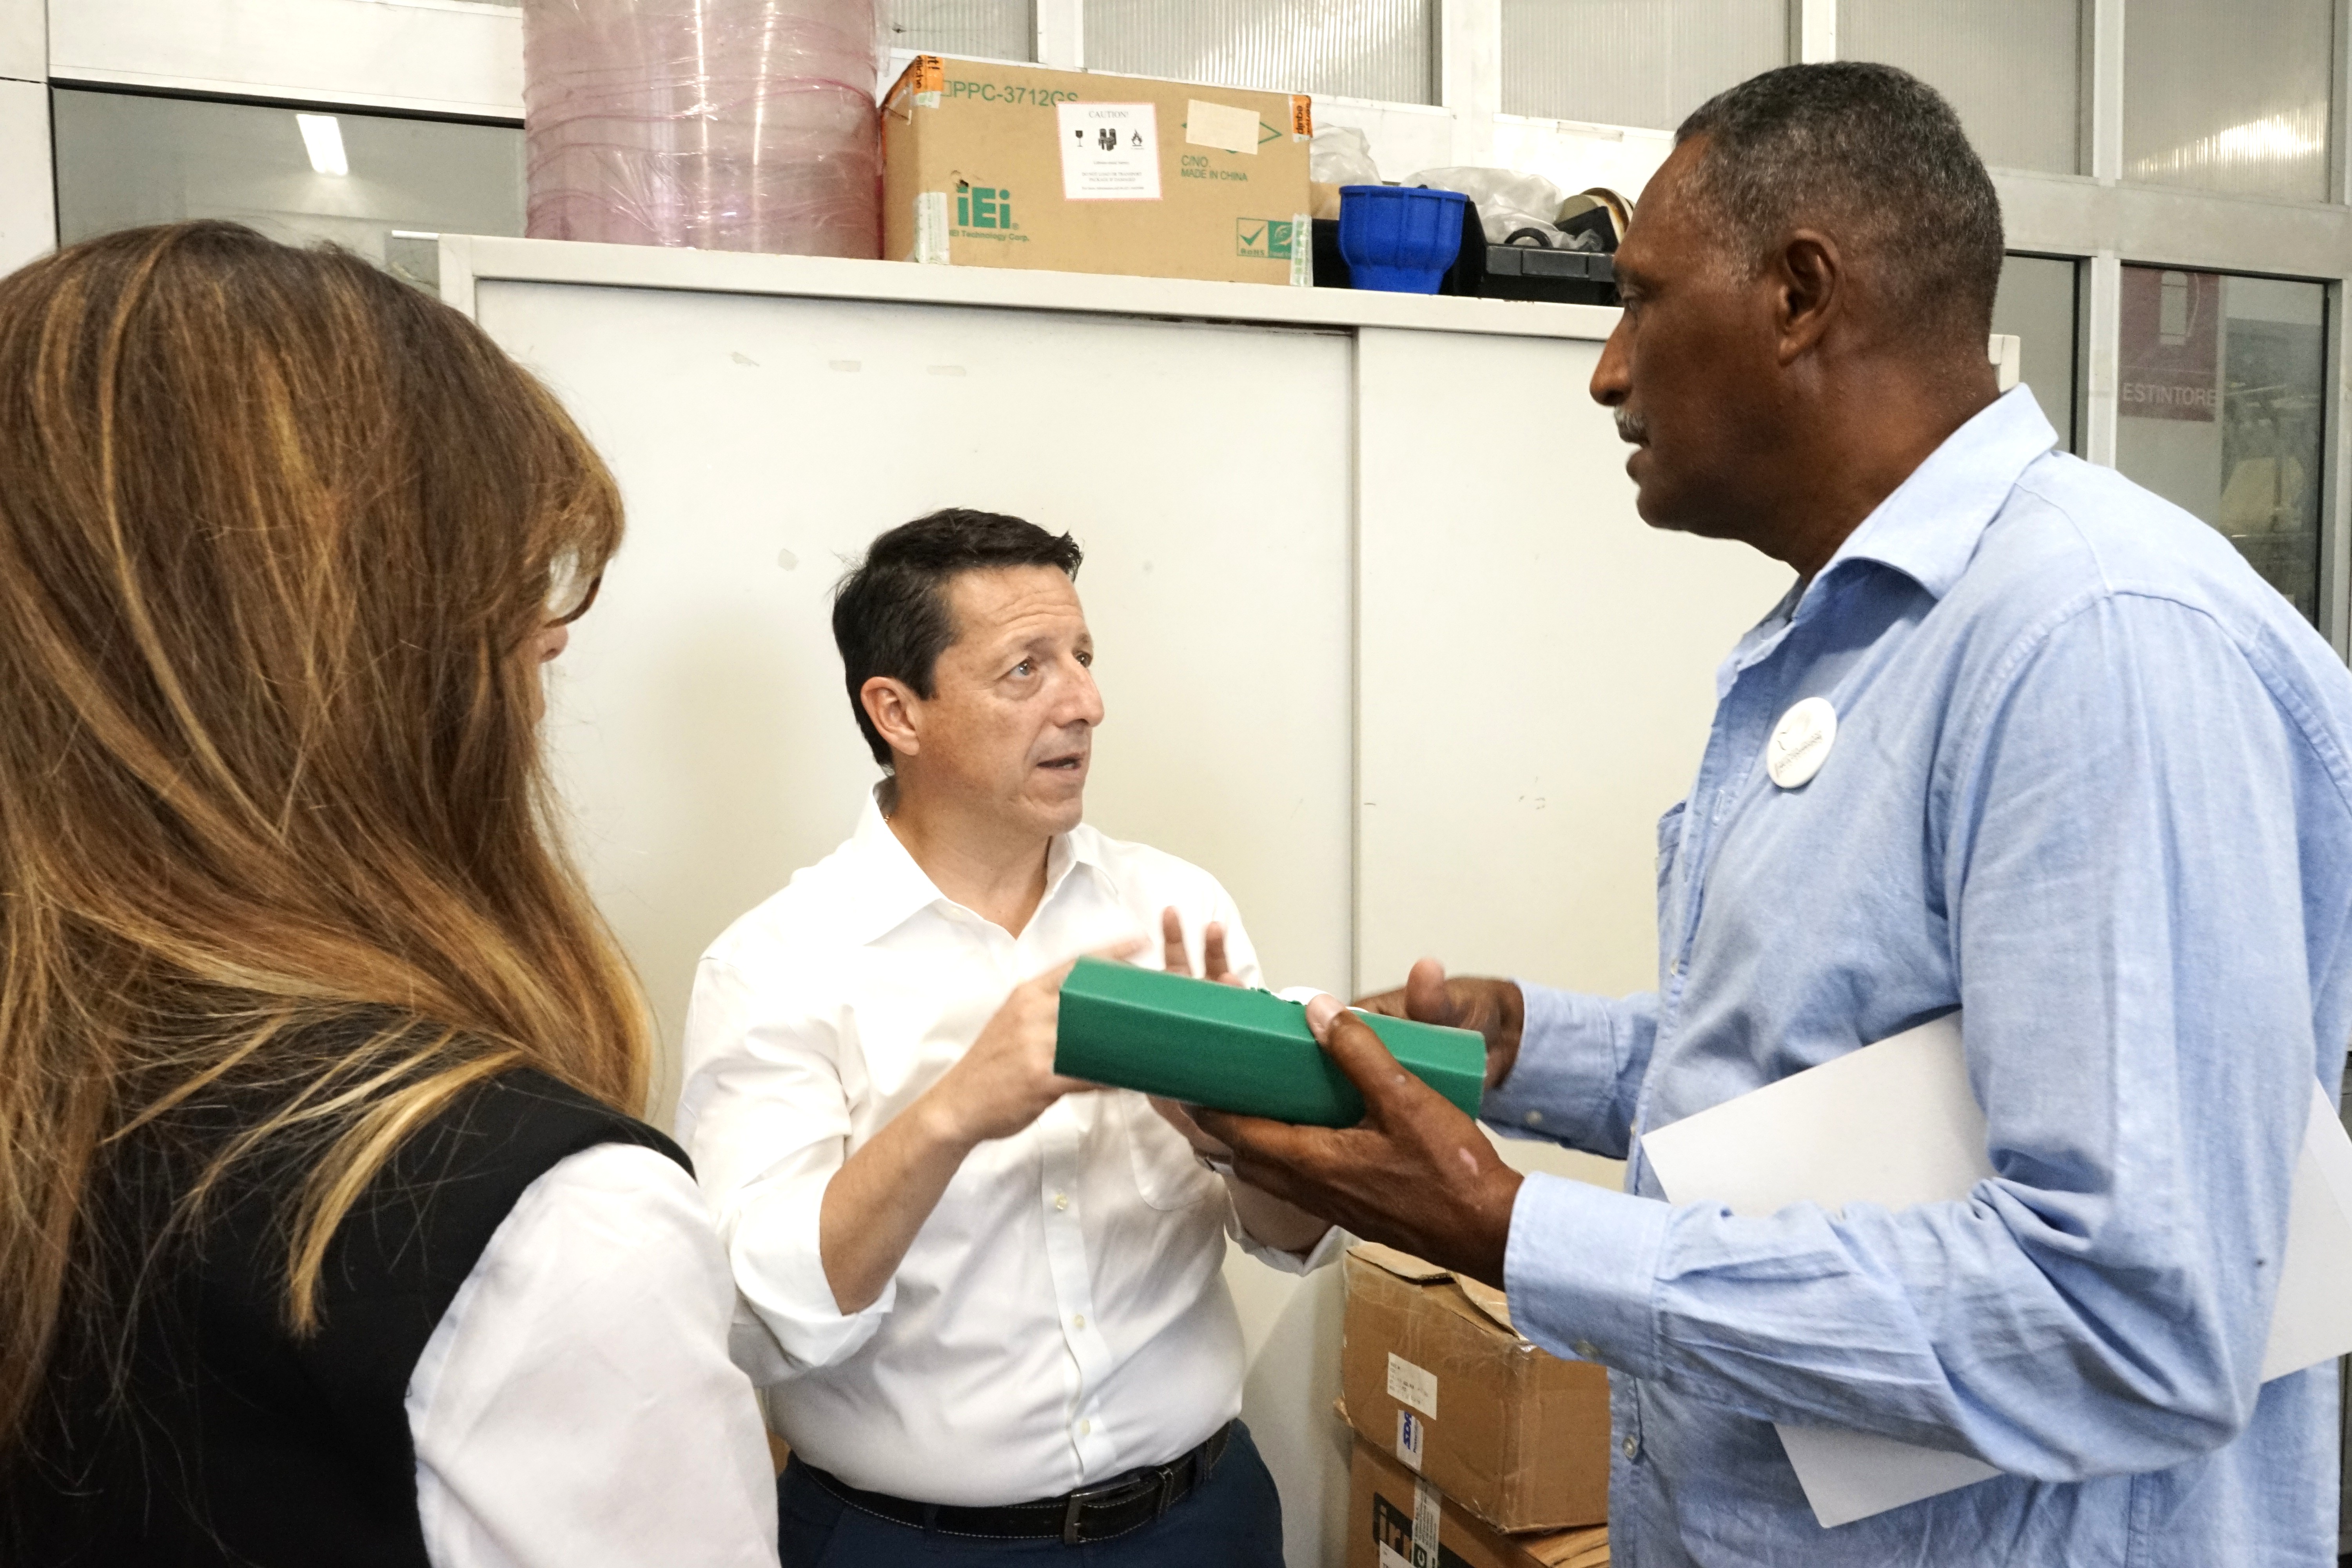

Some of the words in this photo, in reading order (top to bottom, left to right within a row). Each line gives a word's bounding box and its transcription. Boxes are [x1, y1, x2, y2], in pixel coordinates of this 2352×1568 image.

[953, 81, 1078, 107] PPC-3712GS
[1181, 169, 1207, 178] MADE
[1209, 170, 1218, 179] IN
[1220, 171, 1248, 181] CHINA
[961, 230, 1006, 241] Technology
[1009, 233, 1030, 242] Corp.
[2123, 382, 2216, 407] ESTINTORE
